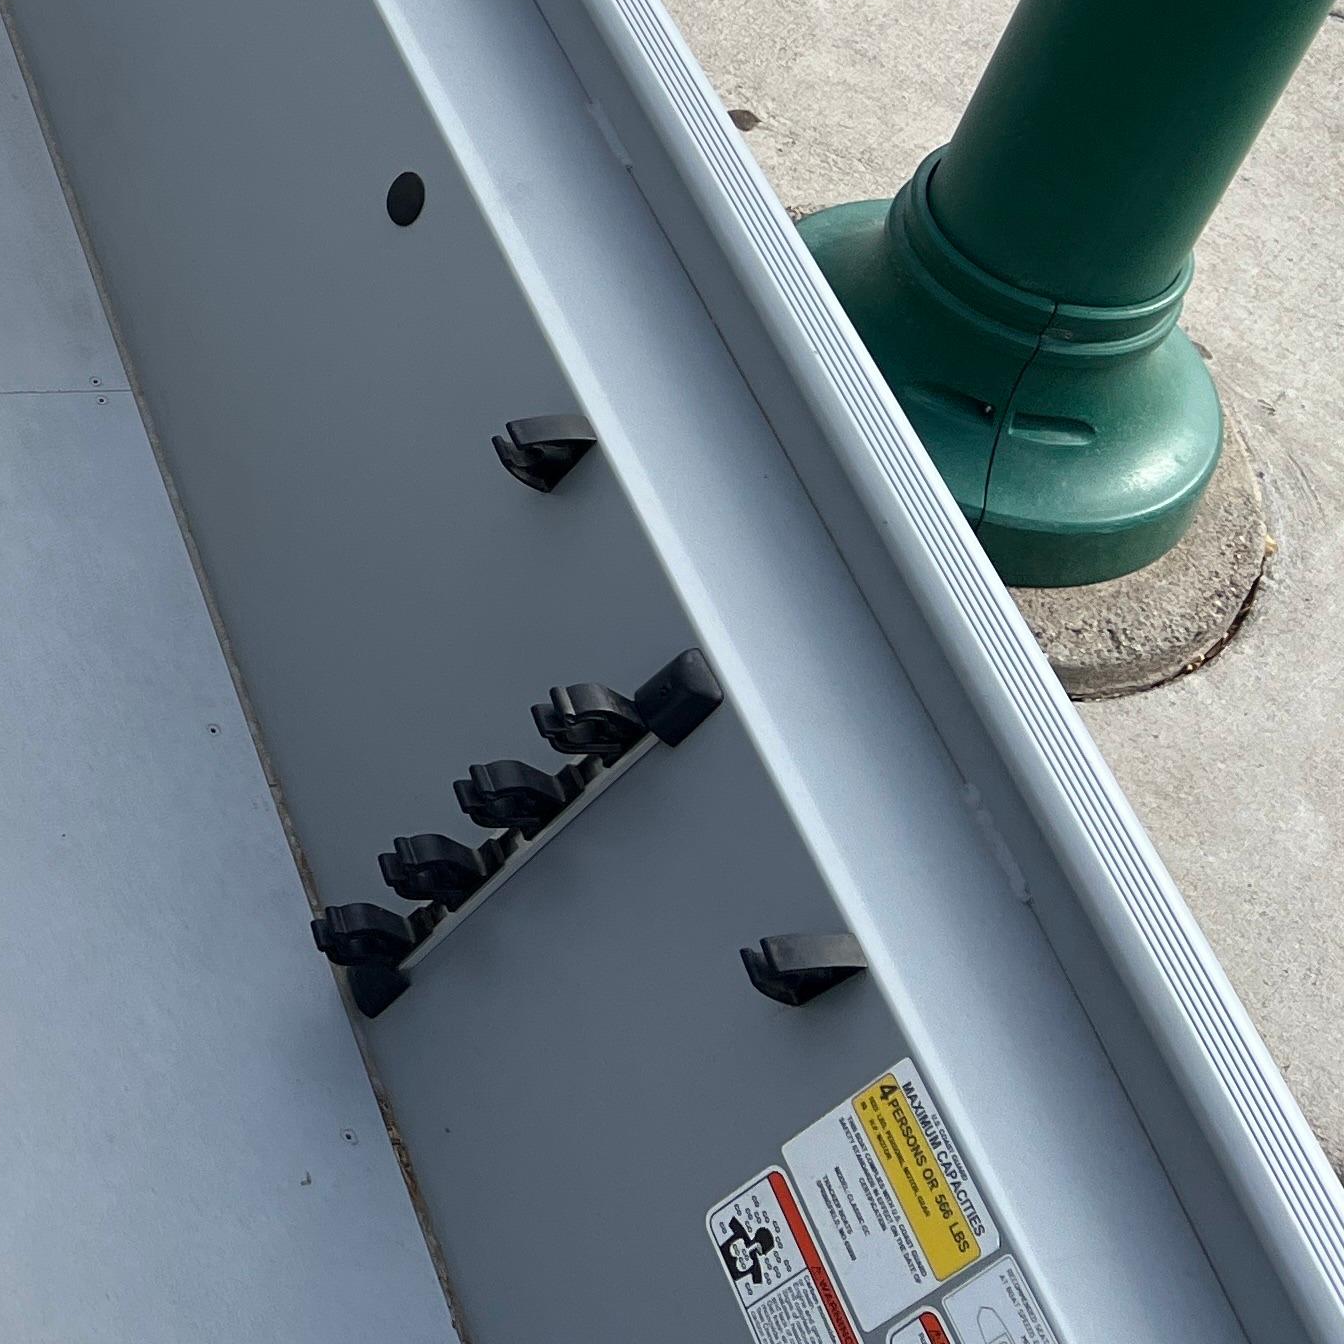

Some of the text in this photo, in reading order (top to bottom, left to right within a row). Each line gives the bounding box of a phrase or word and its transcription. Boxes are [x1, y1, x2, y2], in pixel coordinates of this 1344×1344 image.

[880, 1084, 898, 1102] 4
[887, 1097, 927, 1167] PERSONS
[901, 1080, 986, 1238] MAXIMUM CAPACITIES
[938, 1127, 954, 1154] COAST
[950, 1153, 968, 1182] GUARD
[921, 1166, 940, 1192] OR
[948, 1221, 970, 1253] LBS
